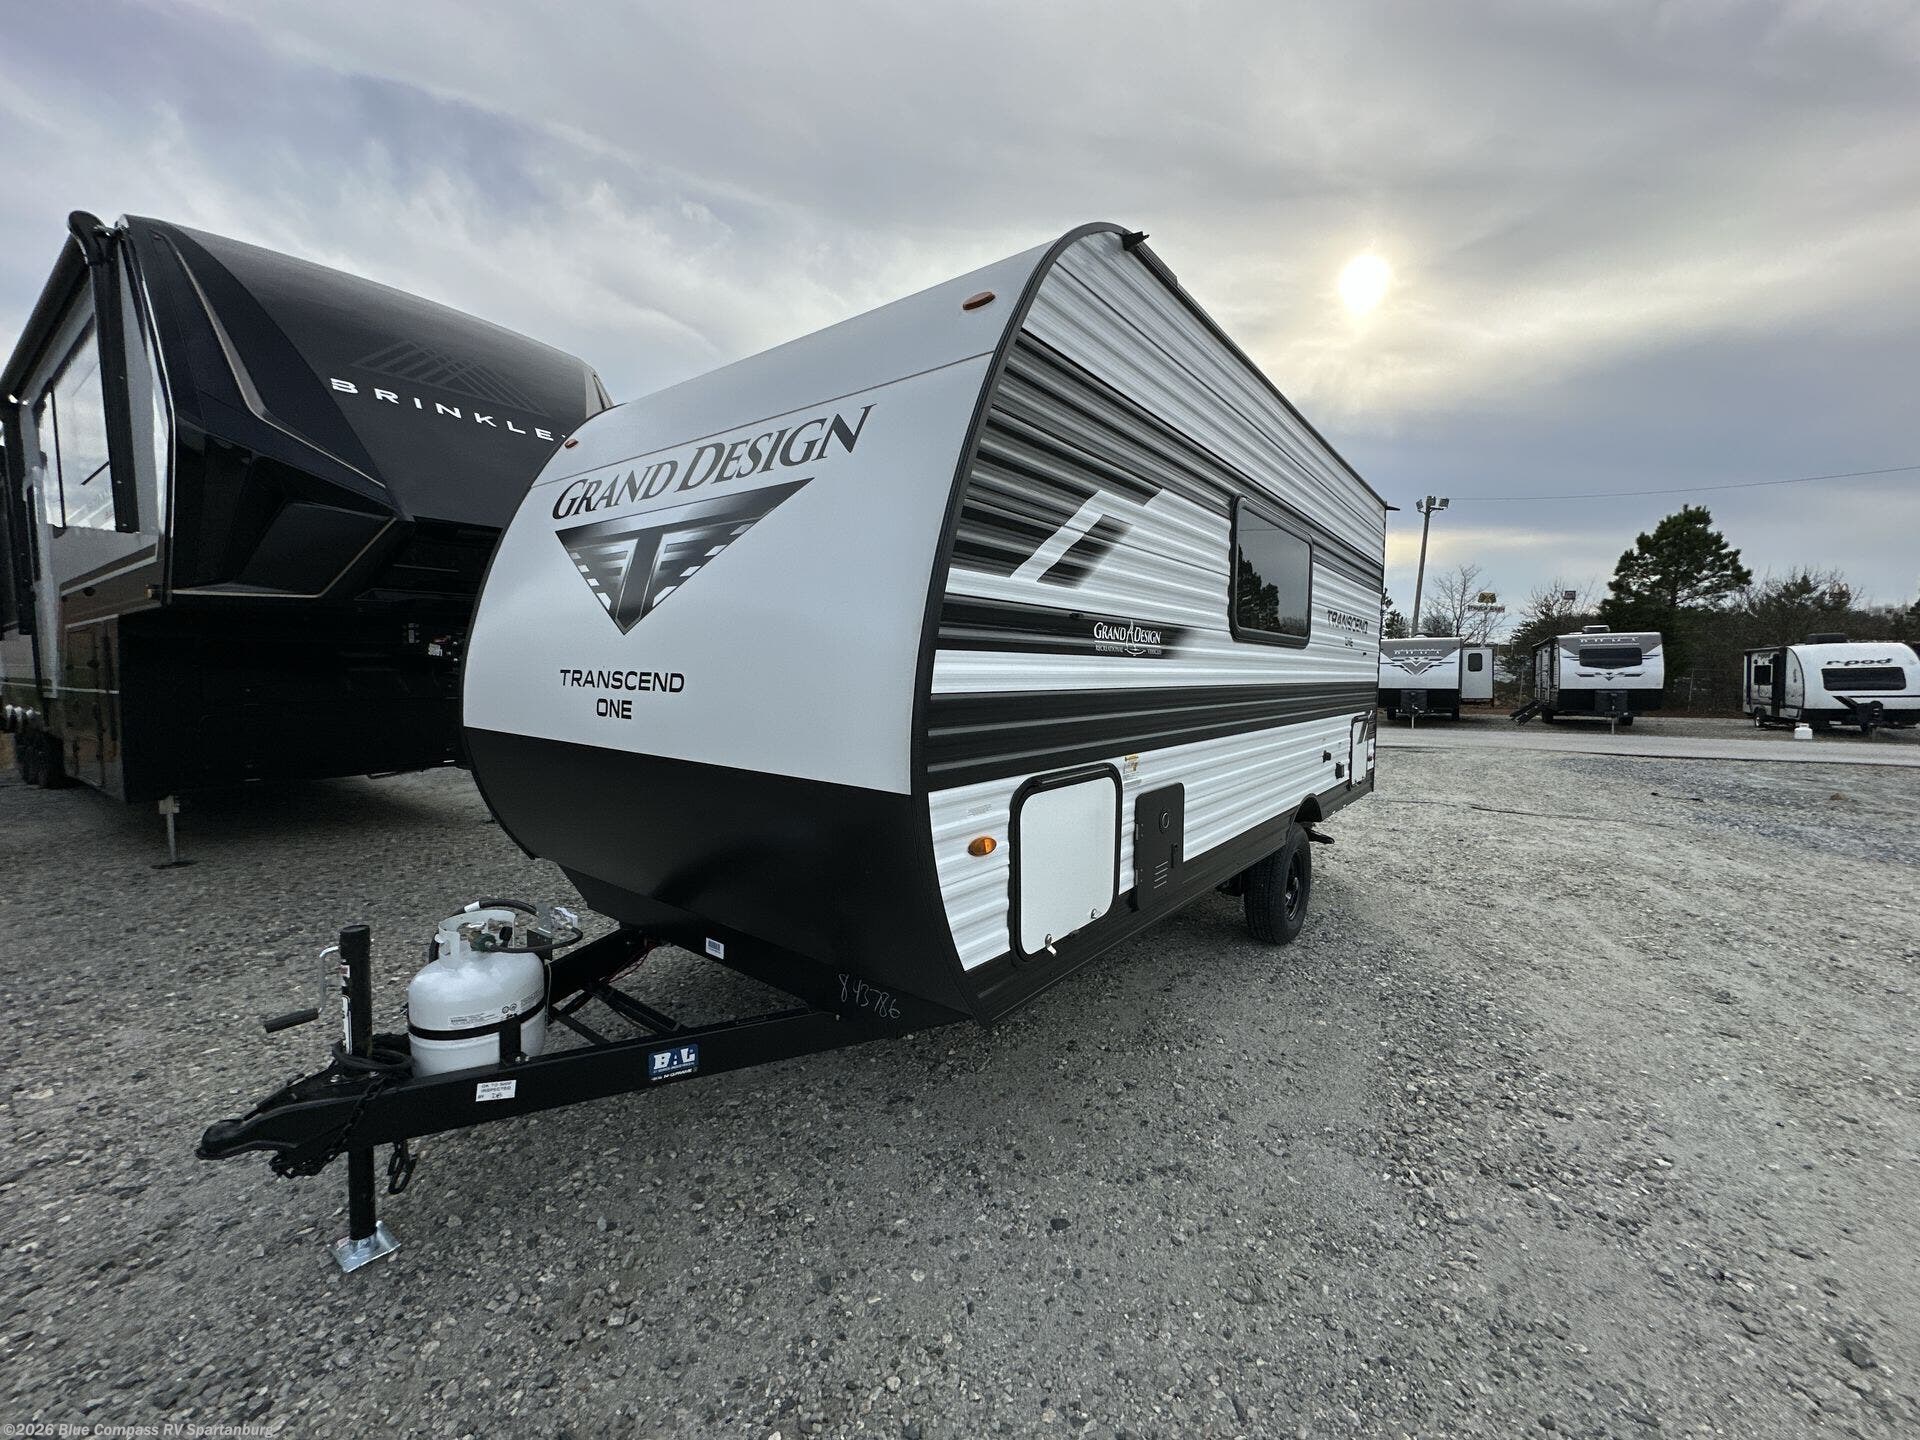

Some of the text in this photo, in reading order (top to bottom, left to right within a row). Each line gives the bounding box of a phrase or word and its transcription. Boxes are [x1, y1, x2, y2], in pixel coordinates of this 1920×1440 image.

[330, 377, 566, 441] BRINKLE
[552, 403, 878, 520] GRAND DESIGN
[1093, 621, 1162, 644] GRAND DESIGN
[1327, 610, 1369, 634] TRANSCEND
[560, 669, 685, 693] TRANSCEND
[596, 698, 633, 720] ONE
[653, 1048, 696, 1070] BAL
